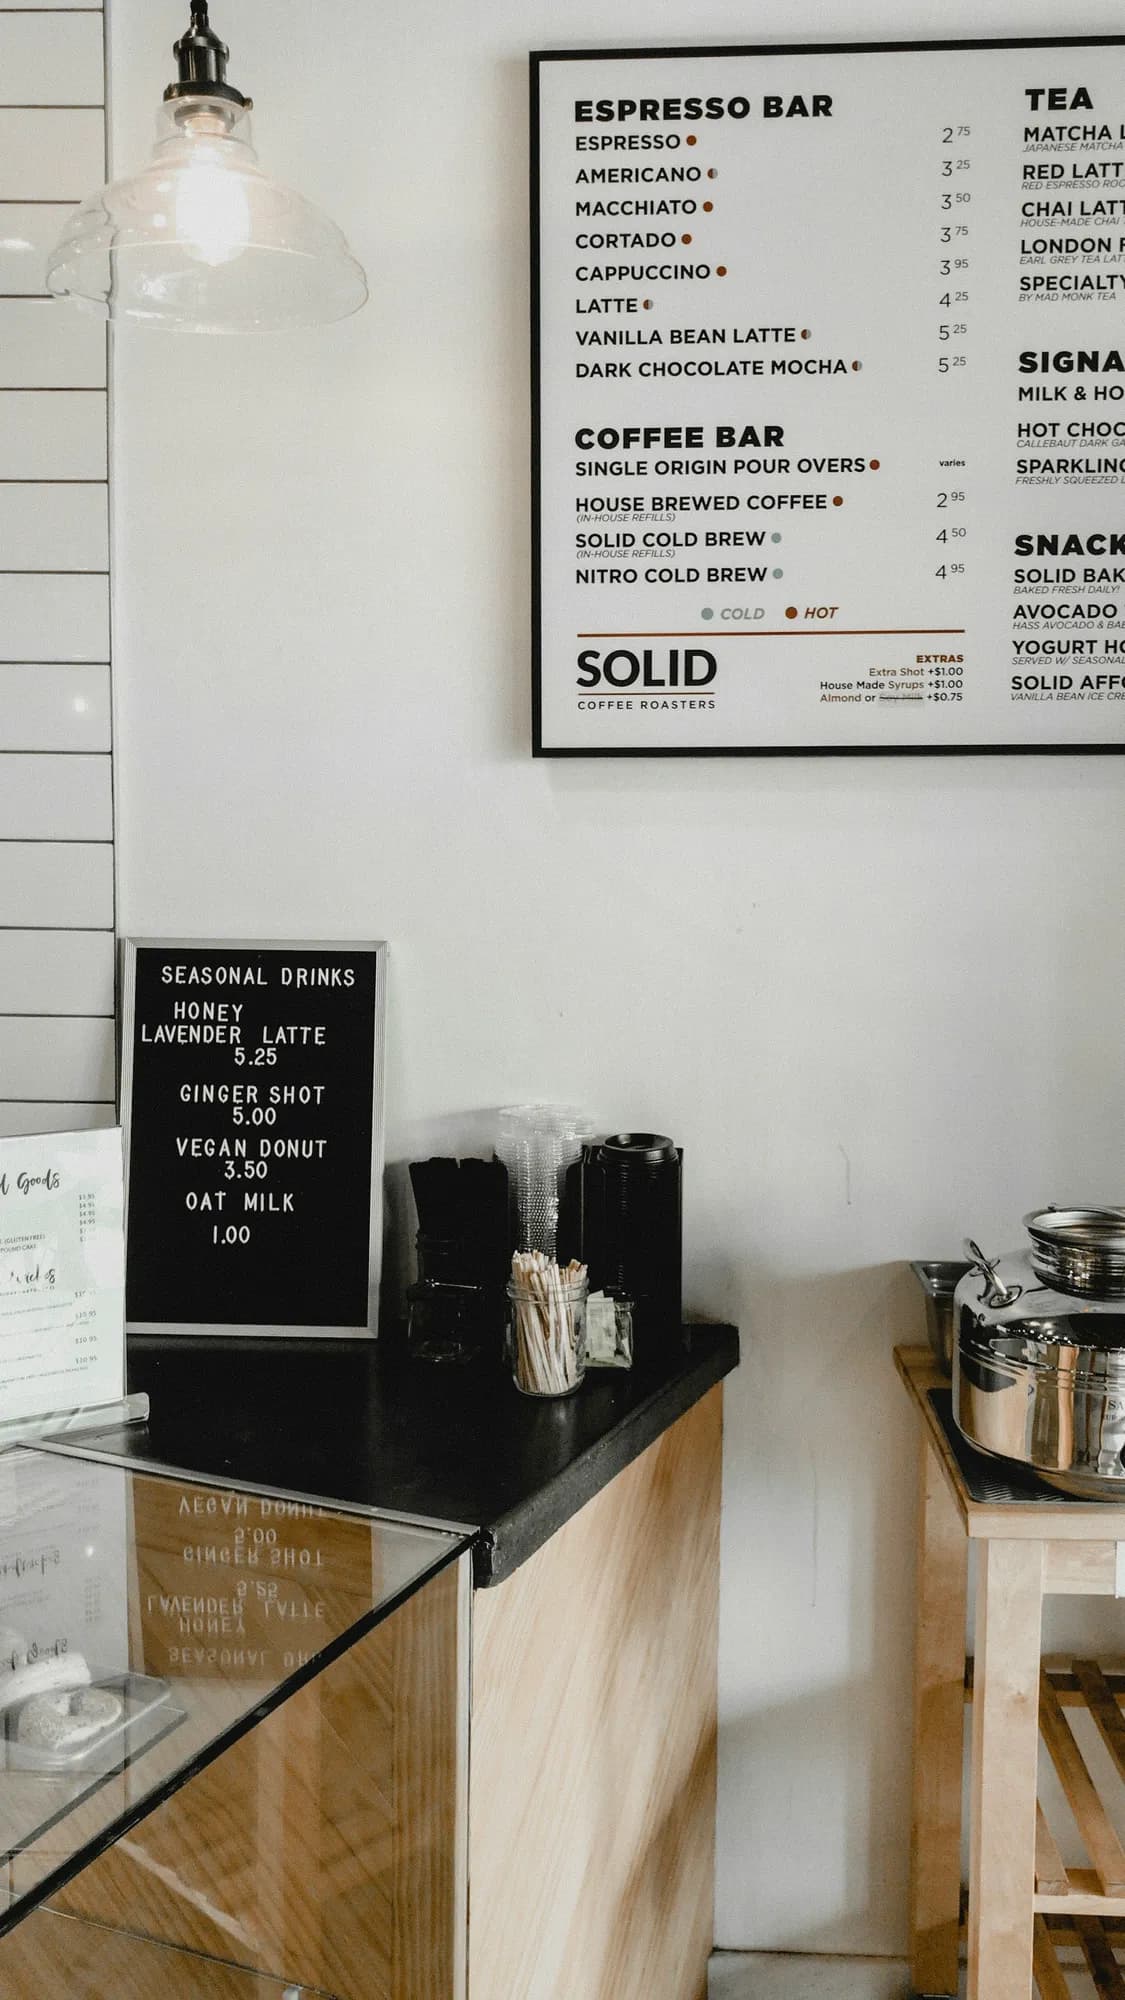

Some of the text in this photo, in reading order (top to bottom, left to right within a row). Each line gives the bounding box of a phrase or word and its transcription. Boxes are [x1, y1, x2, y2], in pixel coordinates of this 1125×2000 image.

[1025, 87, 1093, 111] TEA
[575, 95, 832, 122] ESPRESSO BAR
[1024, 125, 1112, 142] MATCHA
[576, 134, 680, 151] ESPRESSO
[1023, 141, 1123, 152] JAPANESE MATCHA
[576, 167, 701, 183] AMERICANO
[1023, 162, 1124, 180] RED LATT
[1021, 180, 1101, 190] RED ESPRESSO
[576, 200, 696, 216] MACCHIATO
[1022, 201, 1072, 217] CHAI
[1020, 217, 1092, 227] HOUSE-MADE
[1094, 217, 1120, 225] CHAI
[576, 233, 676, 249] CORTADO
[1021, 238, 1111, 254] LONDON
[1020, 256, 1045, 264] EARL
[1050, 255, 1079, 264] GREY
[1082, 255, 1100, 263] TEA
[576, 264, 710, 281] CAPPUCCINO
[1020, 275, 1125, 291] SPECIALTY
[1019, 292, 1116, 302] BY MAD MONK TEA
[576, 298, 637, 313] LATTE
[576, 328, 795, 345] VANILLA BEAN LATTE
[576, 360, 847, 378] DARK CHOCOLATE MOCHA
[1019, 351, 1125, 373] SIGNA
[1019, 386, 1067, 401] MILK
[1074, 386, 1086, 400] &
[1018, 422, 1125, 437] HOT CHOC
[575, 426, 784, 450] COFFEE BAR
[1017, 439, 1109, 448] CALLEBAUT DARK
[576, 458, 865, 476] SINGLE ORIGIN POUR OVERS
[1016, 476, 1061, 484] FRESHLY
[1063, 475, 1119, 484] SQUEEZED
[576, 495, 827, 512] HOUSE BREWED COFFEE
[577, 513, 676, 524] (IN-HOUSE REFILLS)
[576, 531, 766, 548] SOLID COLD BREW
[1014, 534, 1125, 556] SNACK
[576, 549, 675, 559] (IN-HOUSE REFILLS)
[576, 568, 767, 583] NITRO COLD BREW
[1014, 568, 1125, 583] SOLID BAK
[1013, 585, 1120, 594] BAKED FRESH DAILY!
[720, 608, 765, 620] COLD
[804, 607, 839, 619] HOT
[1013, 604, 1117, 619] AVOCADO
[1013, 621, 1040, 629] HASS
[1042, 621, 1094, 629] AVOCADO
[1097, 621, 1103, 629] &
[1012, 640, 1097, 655] YOGURT
[916, 655, 964, 663] EXTRAS
[1012, 656, 1125, 665] SERVED W/ SEASONAL
[576, 650, 717, 687] SOLID
[869, 667, 963, 676] Extra Shot +$1.00
[857, 681, 885, 689] Made
[888, 681, 924, 690] Syrups
[928, 680, 963, 689] +$1.00
[1012, 676, 1073, 690] SOLID
[820, 694, 861, 702] Almond
[927, 693, 963, 702] +$0.75
[1011, 693, 1053, 701] VANILLA
[1056, 692, 1085, 700] BEAN
[1088, 692, 1104, 700] ICE
[578, 700, 715, 710] COFFEE ROASTERS
[162, 966, 354, 988] SEASONAL DRINKS
[175, 1001, 243, 1022] HONEY
[142, 1024, 325, 1045] LAVENDER LATTE
[234, 1047, 277, 1066] 5.25
[180, 1084, 325, 1104] GINGER SHOT
[233, 1107, 276, 1125] 5.00
[176, 1138, 327, 1158] VEGAN DONUT
[225, 1161, 267, 1180] 3.50
[17, 1168, 60, 1195] Goods
[186, 1191, 293, 1212] OAT MILK
[214, 1225, 250, 1244] 1.00
